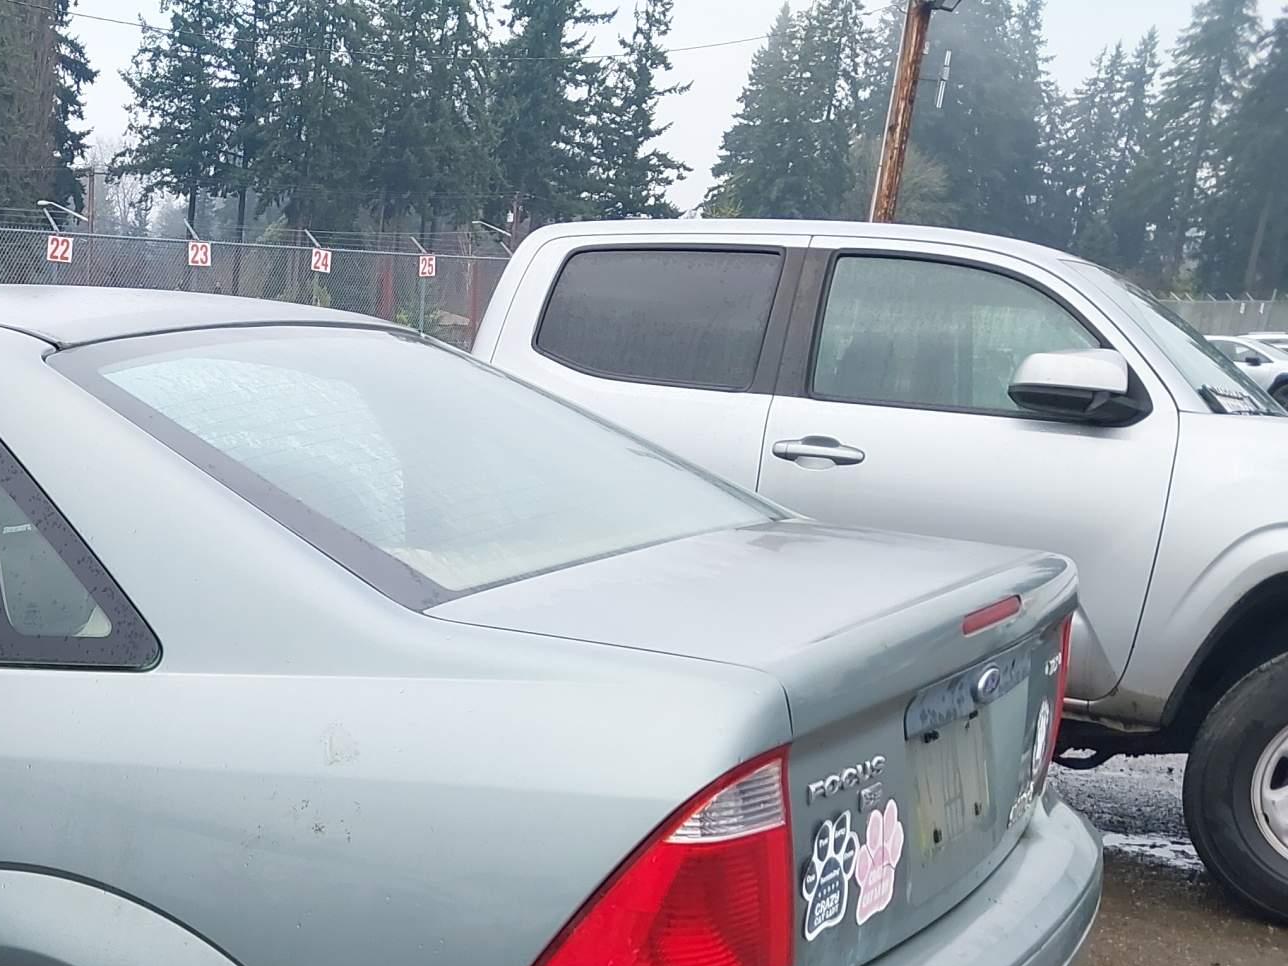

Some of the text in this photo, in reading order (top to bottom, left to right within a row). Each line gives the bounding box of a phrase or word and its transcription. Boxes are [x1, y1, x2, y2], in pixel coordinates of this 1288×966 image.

[49, 237, 70, 260] 22
[190, 243, 208, 265] 23
[313, 250, 329, 271] 24
[420, 257, 434, 275] 25
[807, 754, 886, 802] FOCUS
